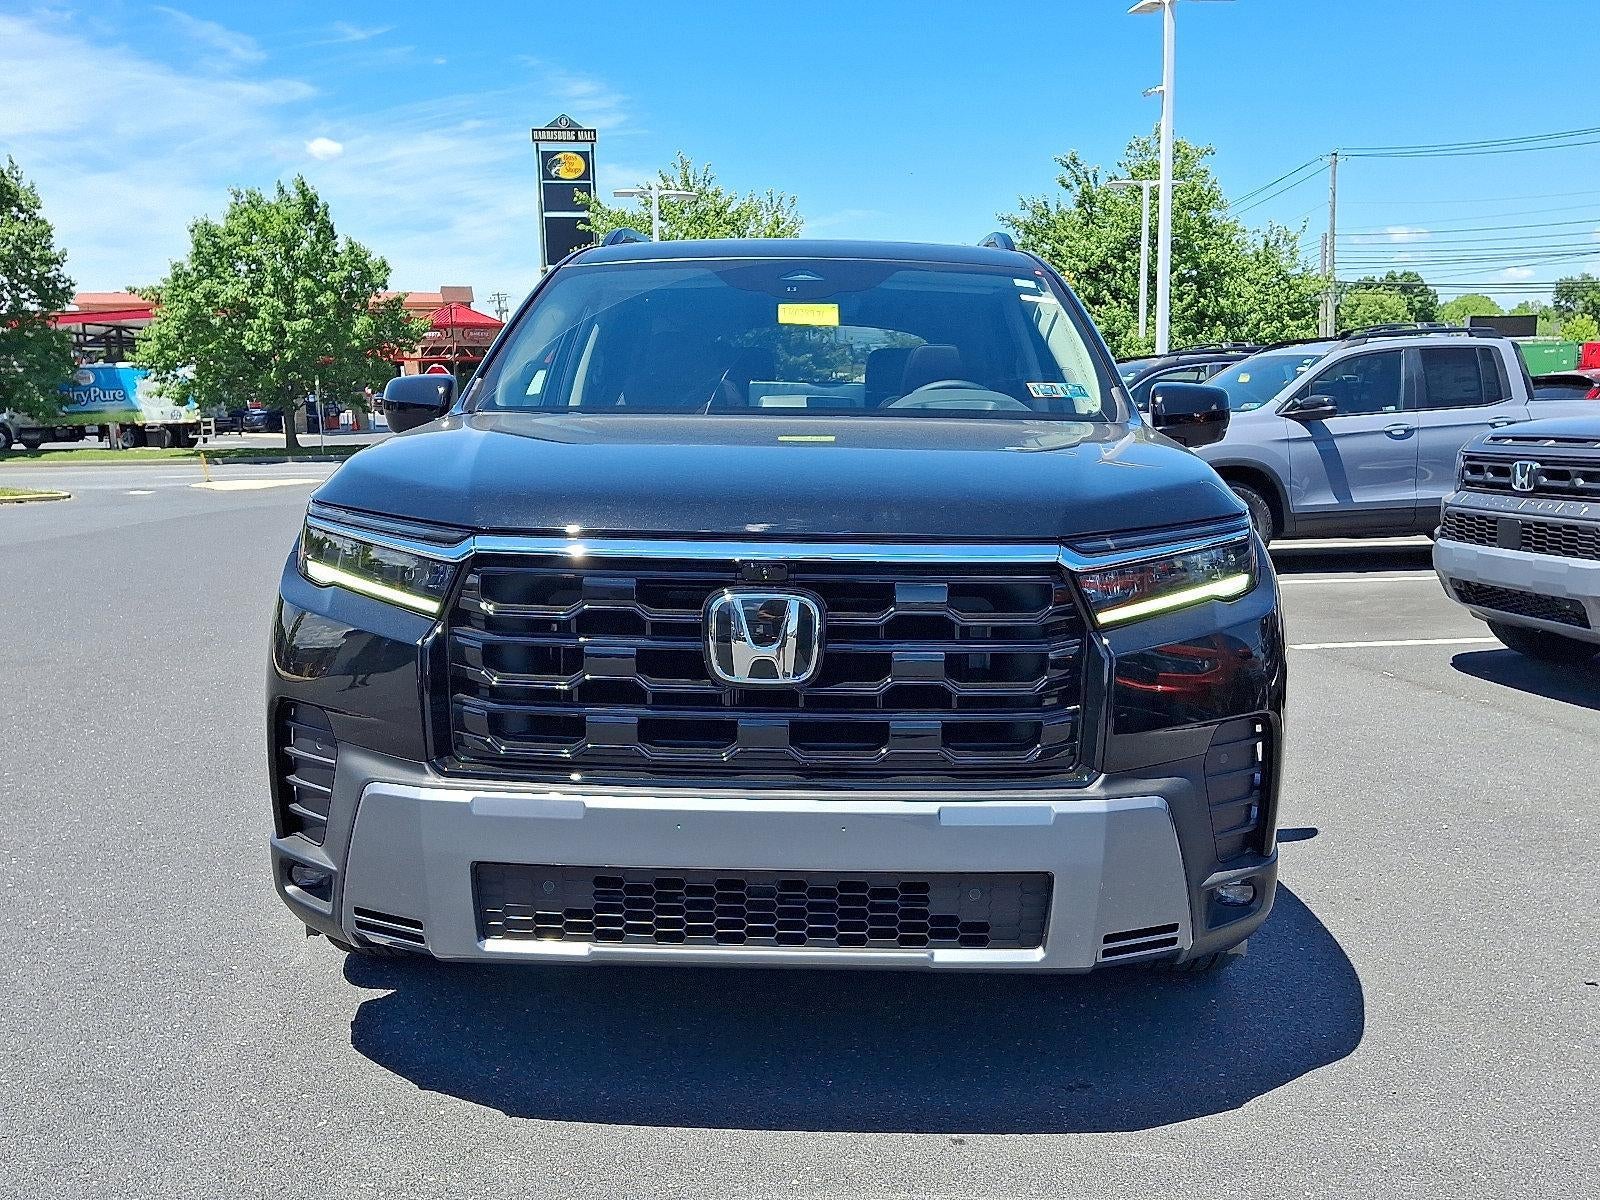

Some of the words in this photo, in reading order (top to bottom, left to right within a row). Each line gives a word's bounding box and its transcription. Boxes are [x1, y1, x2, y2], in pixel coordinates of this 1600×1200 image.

[533, 130, 576, 141] HARRISBURG
[577, 130, 596, 141] MALL
[564, 167, 582, 175] Shops
[54, 387, 125, 406] iryPure
